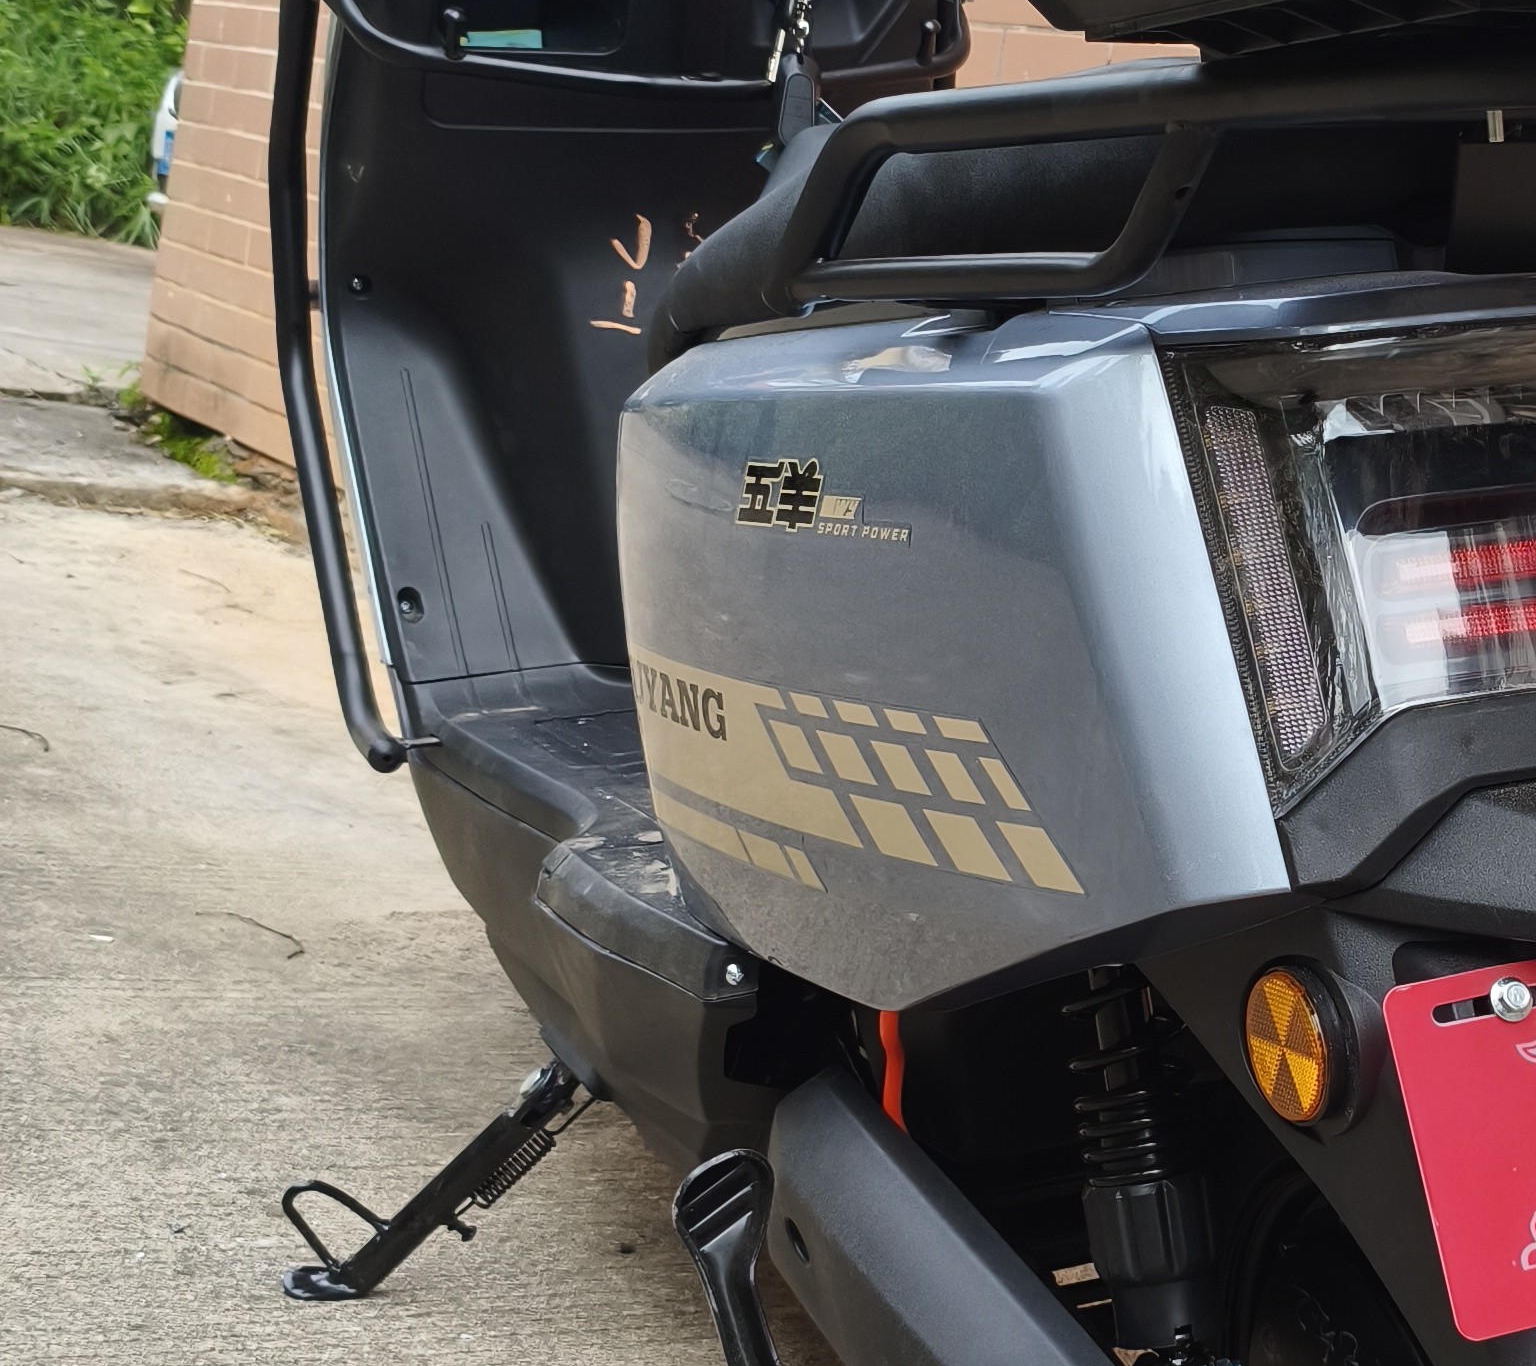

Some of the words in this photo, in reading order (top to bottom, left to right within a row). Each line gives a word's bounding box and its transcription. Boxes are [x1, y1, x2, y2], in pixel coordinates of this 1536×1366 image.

[736, 458, 824, 532] 五羊
[817, 521, 858, 538] SPORT
[861, 524, 910, 542] POWER
